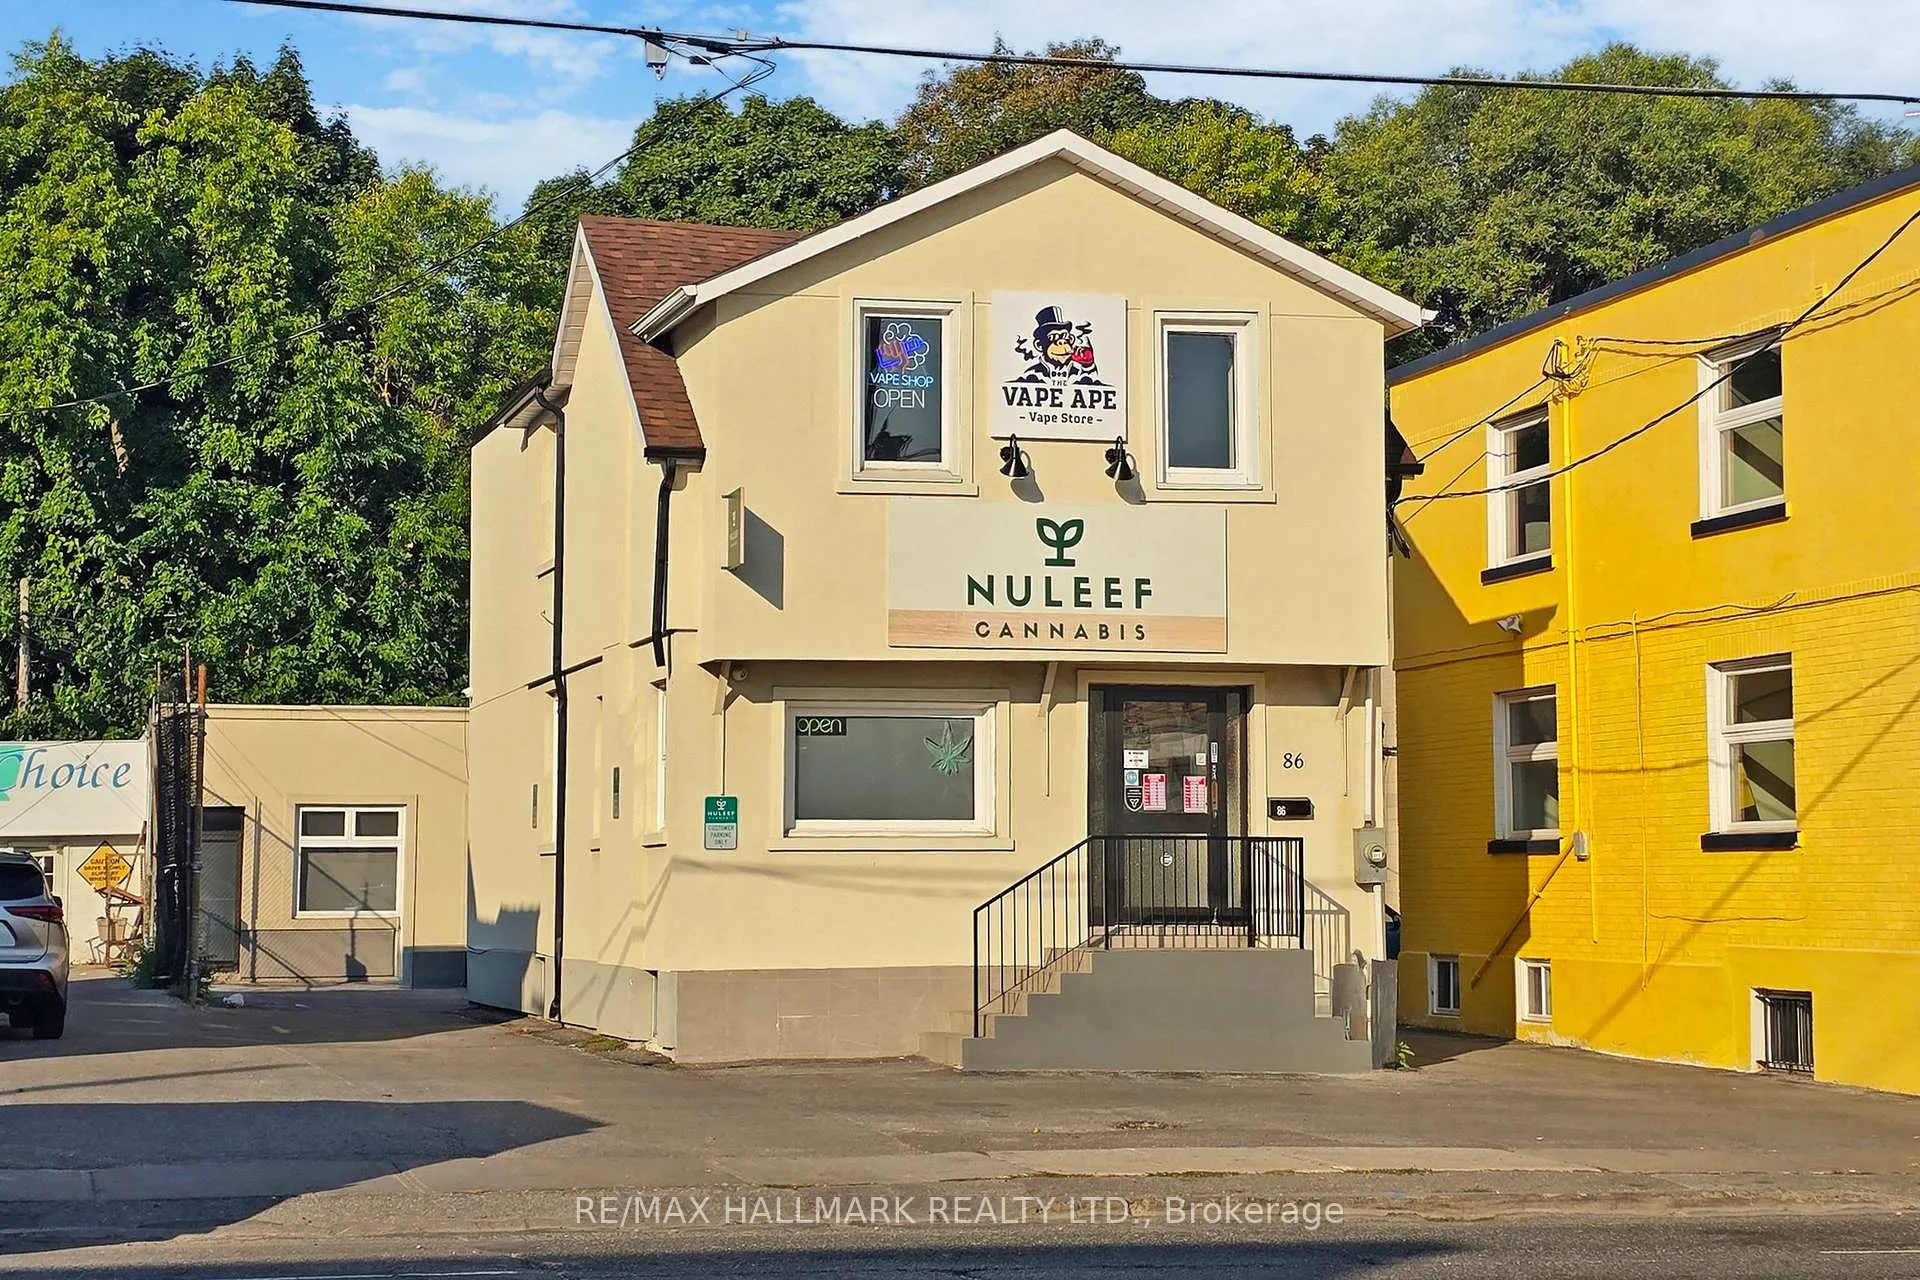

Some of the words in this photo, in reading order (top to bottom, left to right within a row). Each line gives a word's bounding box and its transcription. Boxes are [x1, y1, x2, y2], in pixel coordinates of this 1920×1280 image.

[870, 373, 900, 386] VAPE
[901, 374, 934, 388] SHOP
[873, 388, 925, 409] OPEN
[1002, 386, 1063, 408] VAPE
[1070, 388, 1117, 410] APE
[1029, 411, 1058, 425] Vape
[1061, 412, 1094, 424] Store
[967, 574, 1152, 609] NULEEF
[975, 621, 1146, 641] CANNABIS
[797, 718, 842, 737] open
[1283, 752, 1304, 769] 86
[1276, 805, 1287, 817] 86
